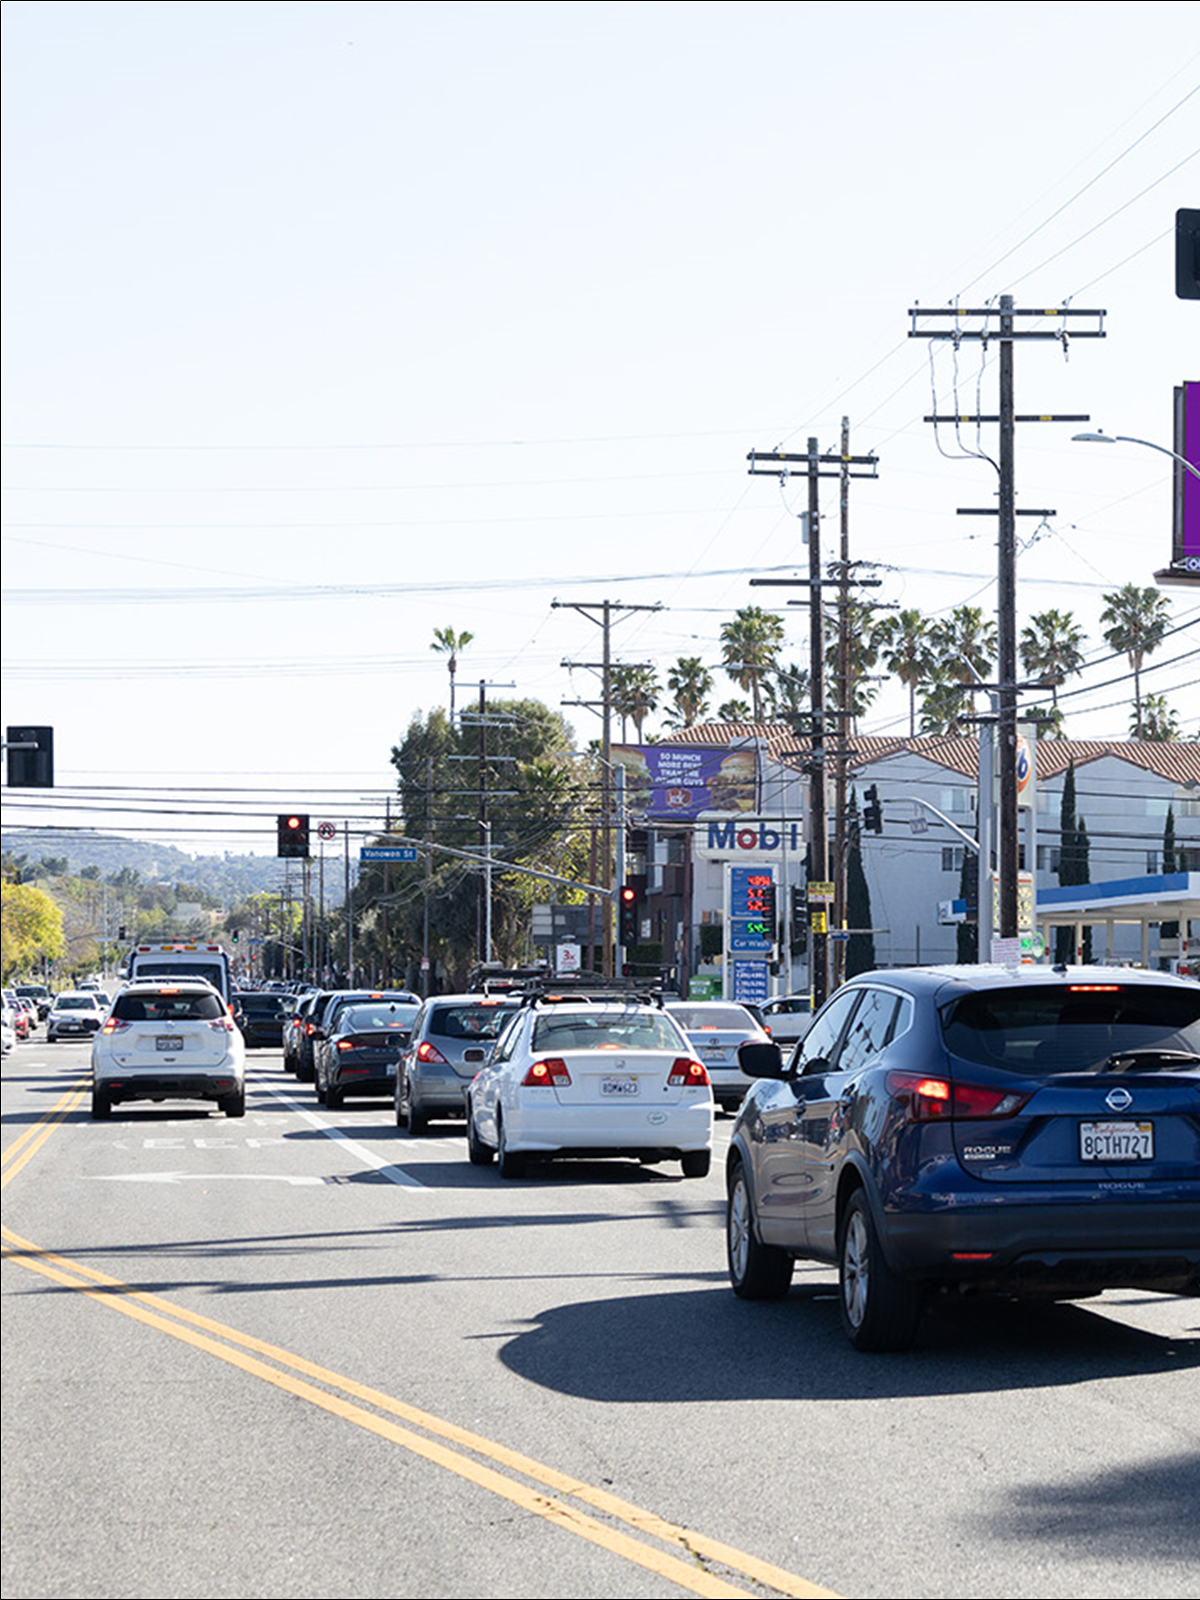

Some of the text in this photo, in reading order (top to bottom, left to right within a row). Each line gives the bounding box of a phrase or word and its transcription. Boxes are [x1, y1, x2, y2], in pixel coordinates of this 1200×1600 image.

[683, 778, 704, 786] GUYS
[734, 939, 746, 947] Car
[1094, 1124, 1136, 1135] California
[1084, 1136, 1150, 1154] 8CTH727
[963, 1145, 1011, 1154] ROGUE
[1098, 1182, 1146, 1190] ROGUE
